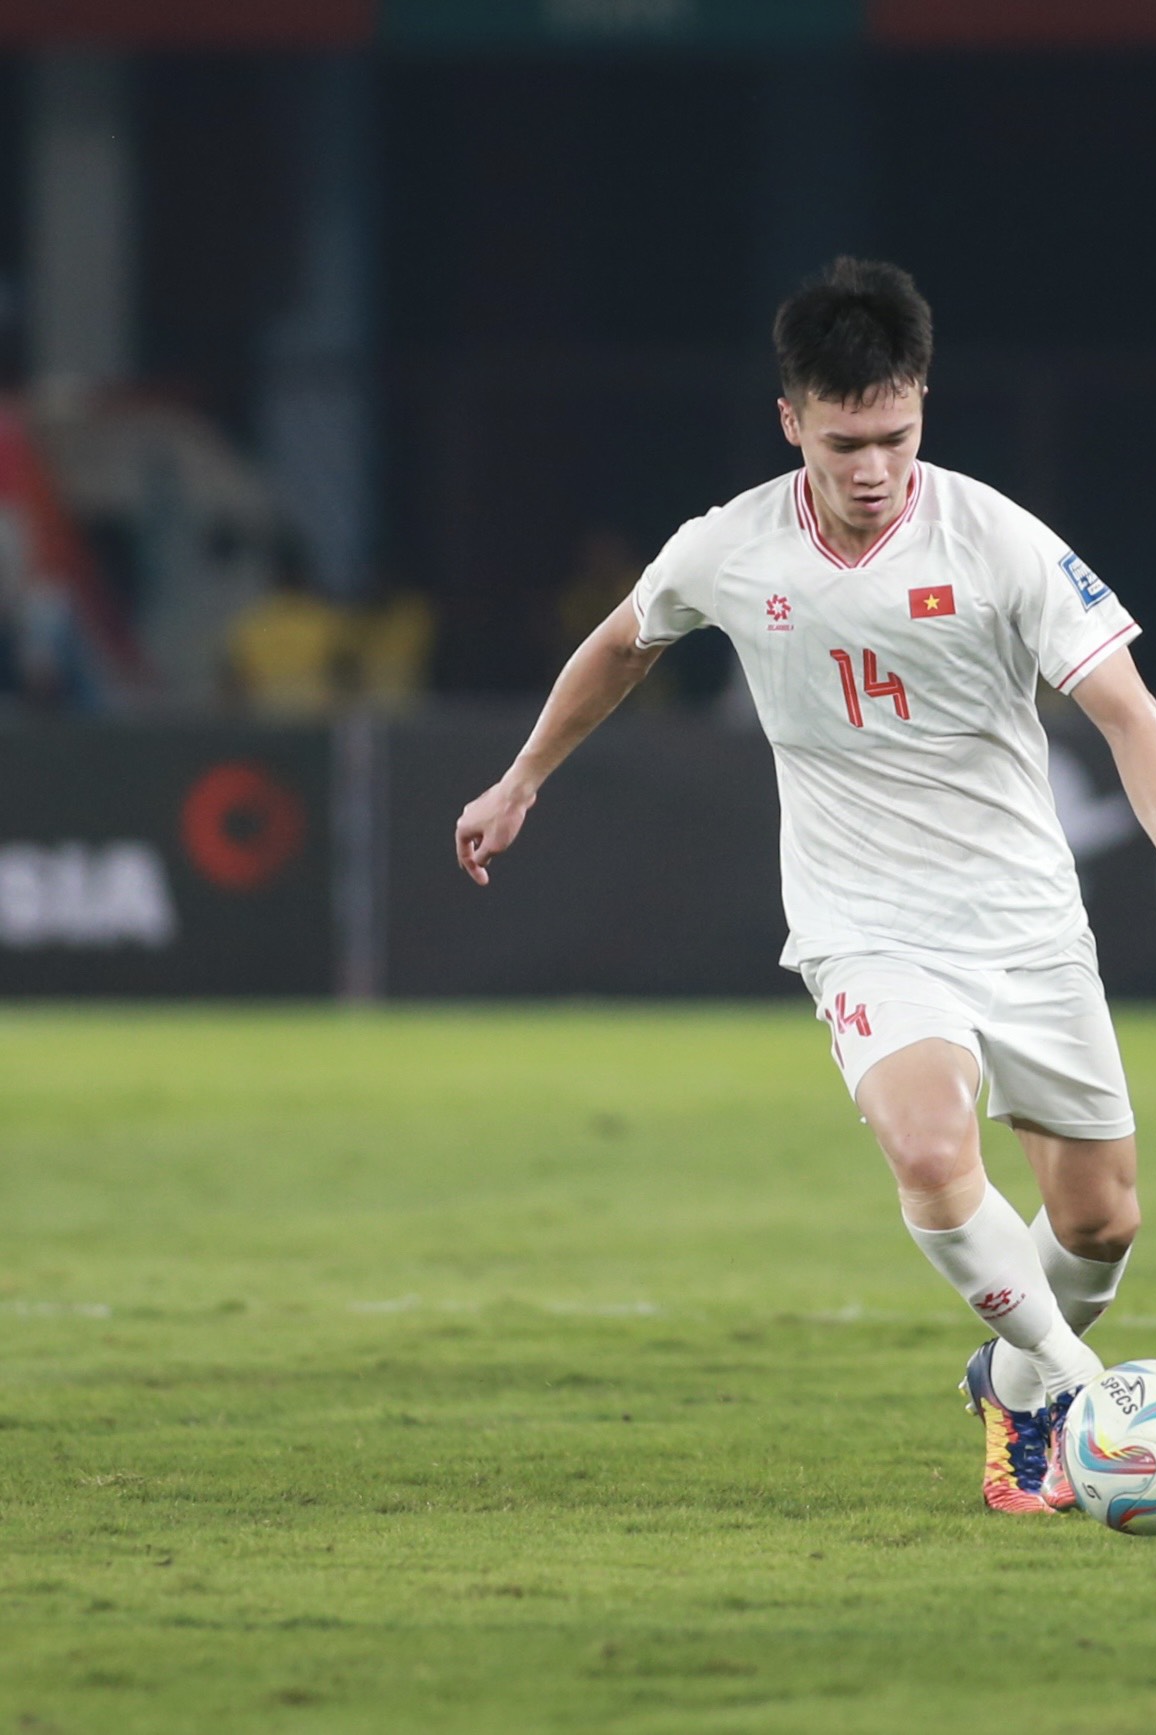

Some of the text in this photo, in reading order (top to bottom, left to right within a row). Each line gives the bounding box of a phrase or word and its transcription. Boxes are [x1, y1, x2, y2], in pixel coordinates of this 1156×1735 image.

[830, 648, 910, 728] 14
[824, 992, 872, 1037] 4
[1100, 1376, 1139, 1415] SPECS
